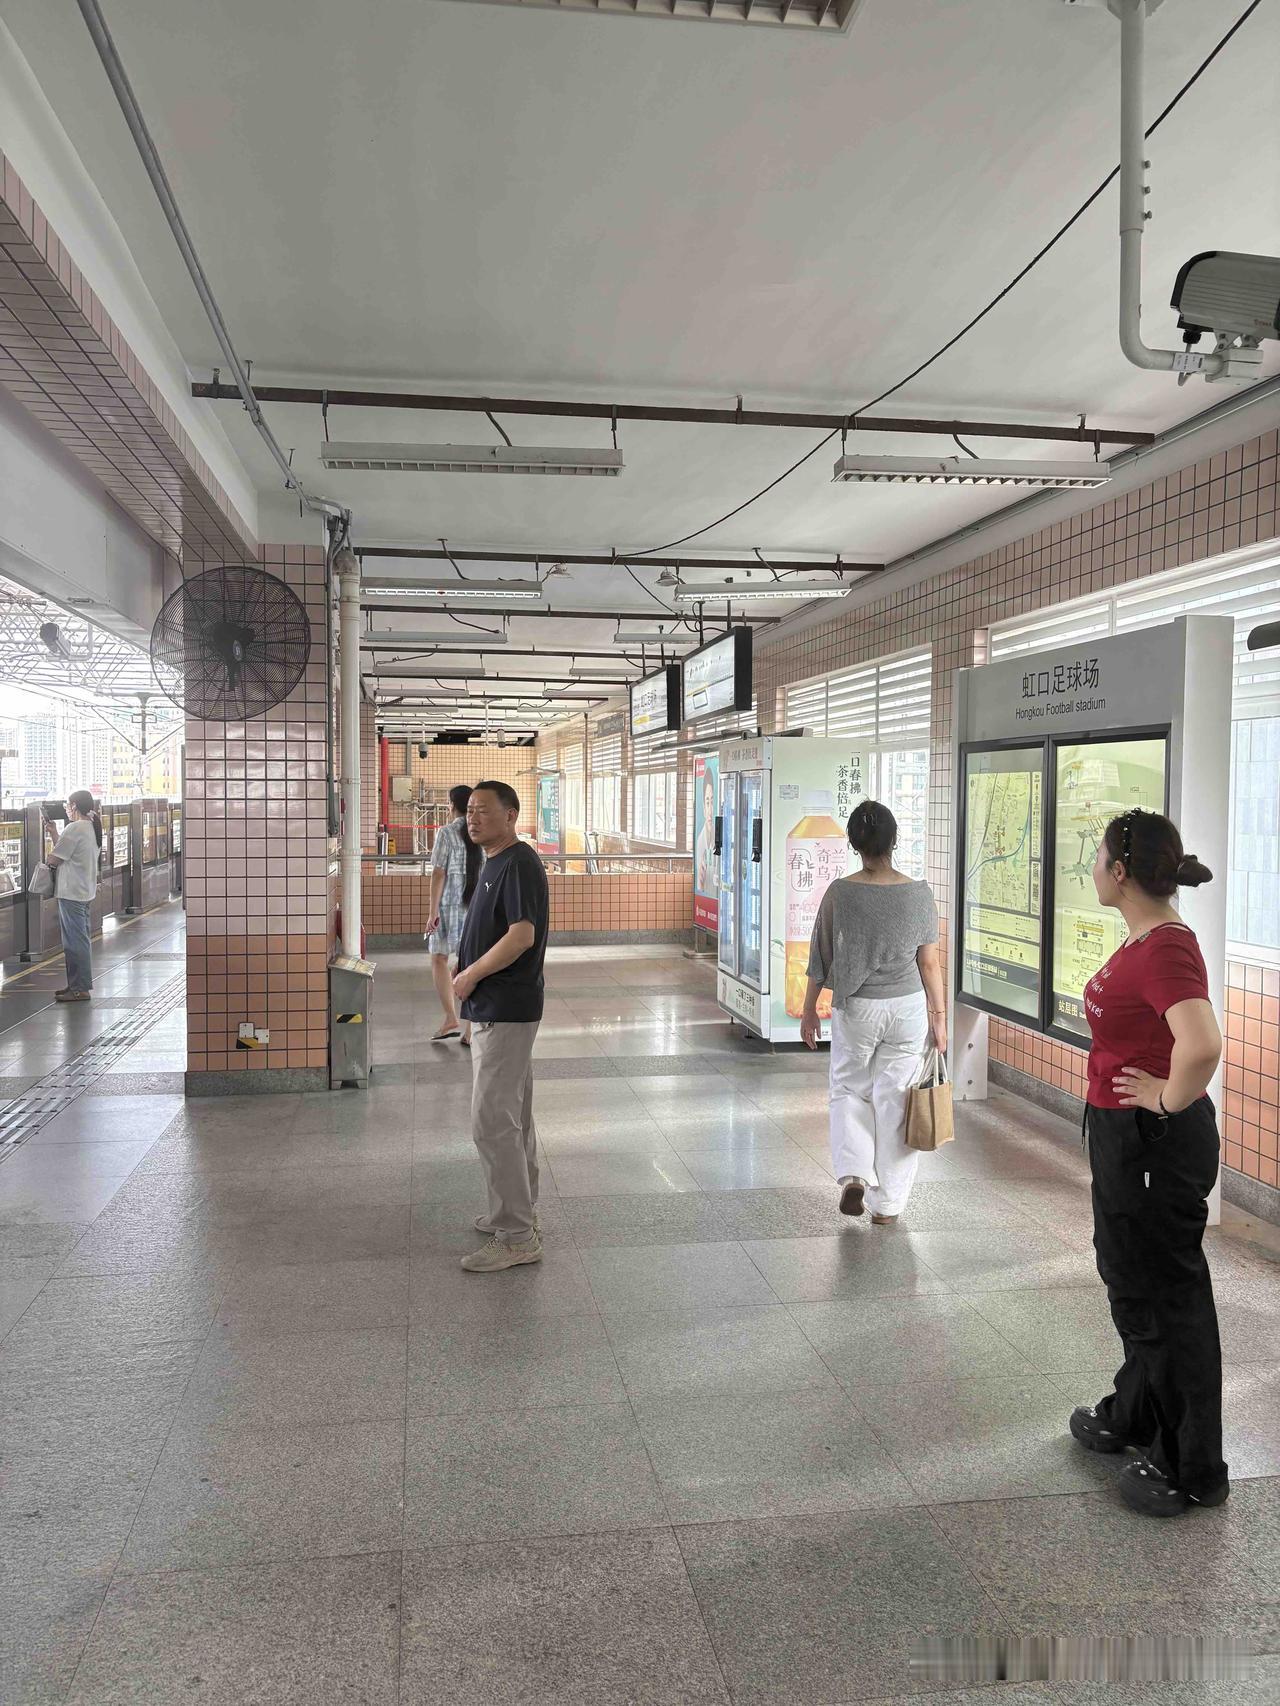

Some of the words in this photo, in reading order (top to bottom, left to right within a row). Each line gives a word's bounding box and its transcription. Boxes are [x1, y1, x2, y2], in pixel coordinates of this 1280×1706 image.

[1022, 658, 1099, 699] 虹口足球场
[1015, 706, 1044, 720] Hongkou
[1046, 700, 1074, 715] Football
[1075, 697, 1106, 712] stadium
[836, 764, 849, 819] 茶香倍足
[850, 751, 861, 794] 一口春拂
